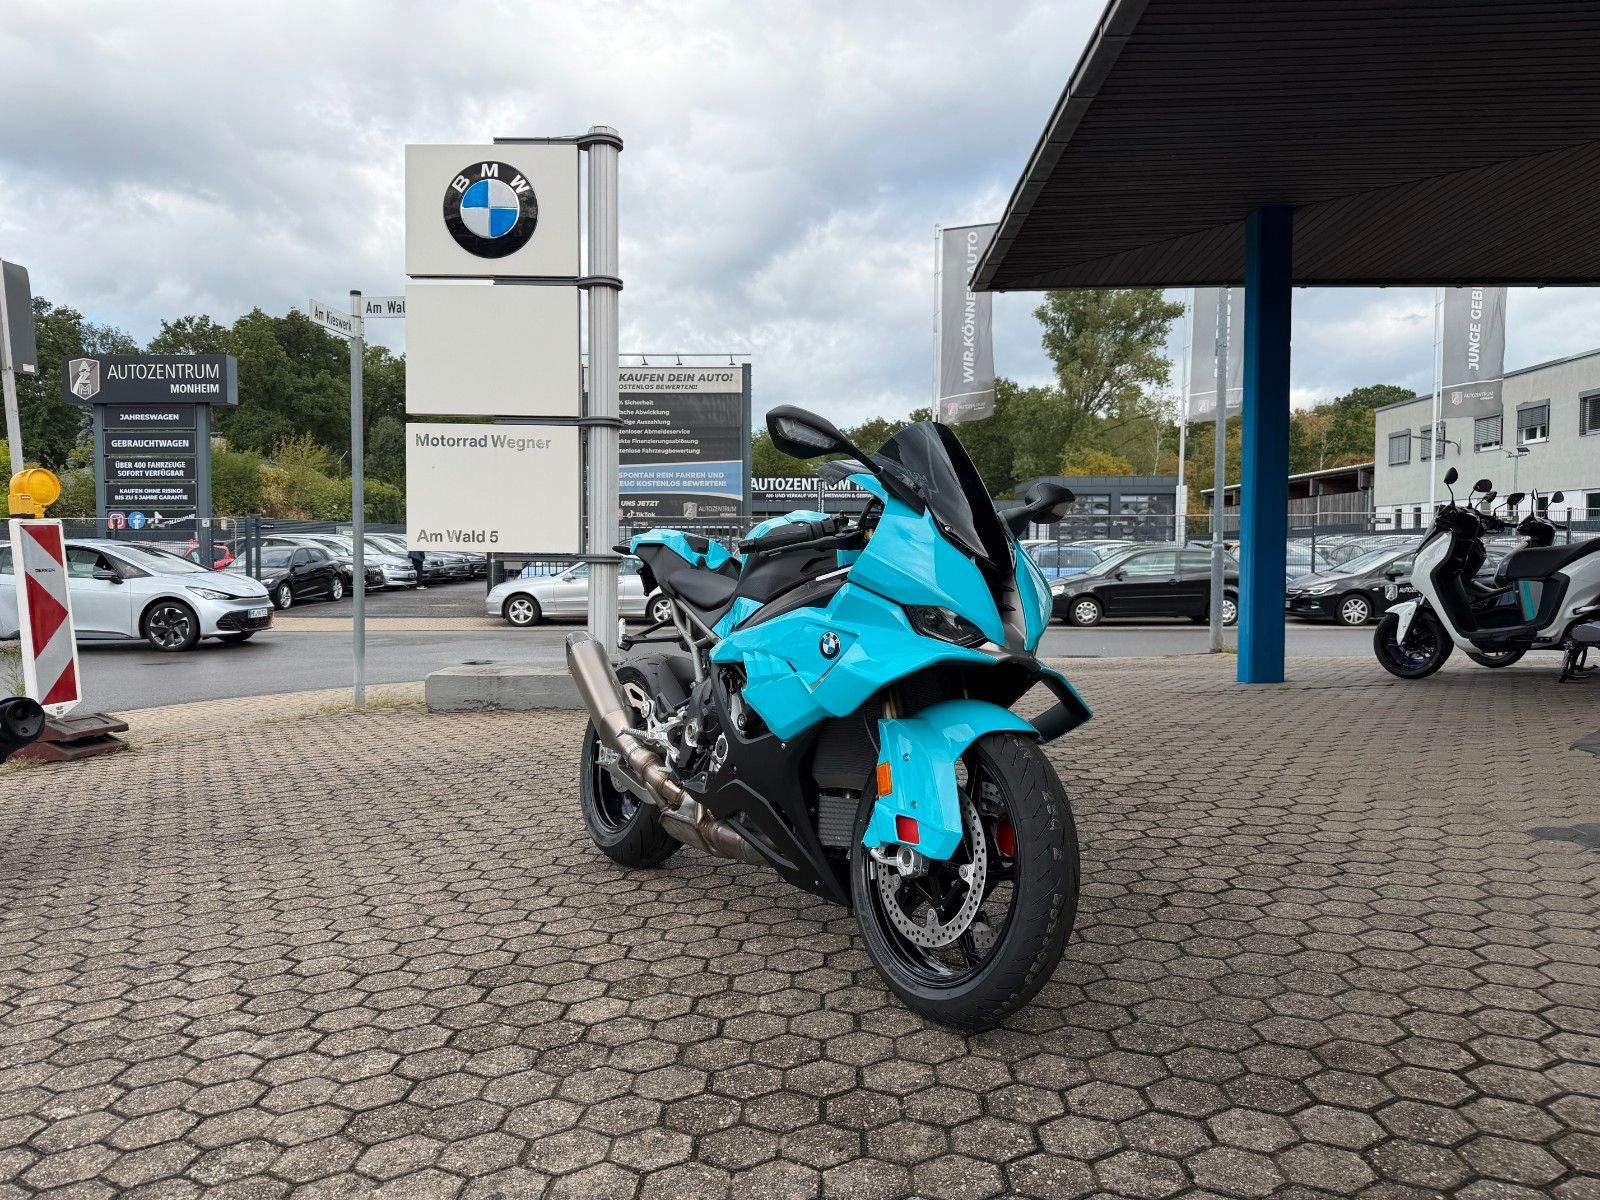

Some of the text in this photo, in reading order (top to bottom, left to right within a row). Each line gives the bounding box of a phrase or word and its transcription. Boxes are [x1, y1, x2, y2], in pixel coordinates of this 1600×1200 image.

[451, 163, 530, 194] BMW
[366, 300, 406, 314] Am Wal
[314, 305, 353, 332] Am Kieswerk
[1468, 287, 1483, 371] JUNGE GEB
[107, 363, 220, 380] AUTOZENTRUM
[618, 373, 734, 382] KAUFEN DEIN AUTO!
[170, 383, 220, 394] MONHEIM
[119, 413, 180, 421] JAHRESWAGEN
[111, 439, 189, 448] GEBRAUCHTWAGEN
[415, 433, 551, 451] Motorrad Wegner
[115, 460, 186, 469] ÜBER 400 FAHRZEUGE
[144, 469, 185, 477] VERFÜGBAR
[619, 471, 724, 479] SPONTAN REIN FAHREN UND
[416, 529, 499, 543] Am Wald 5
